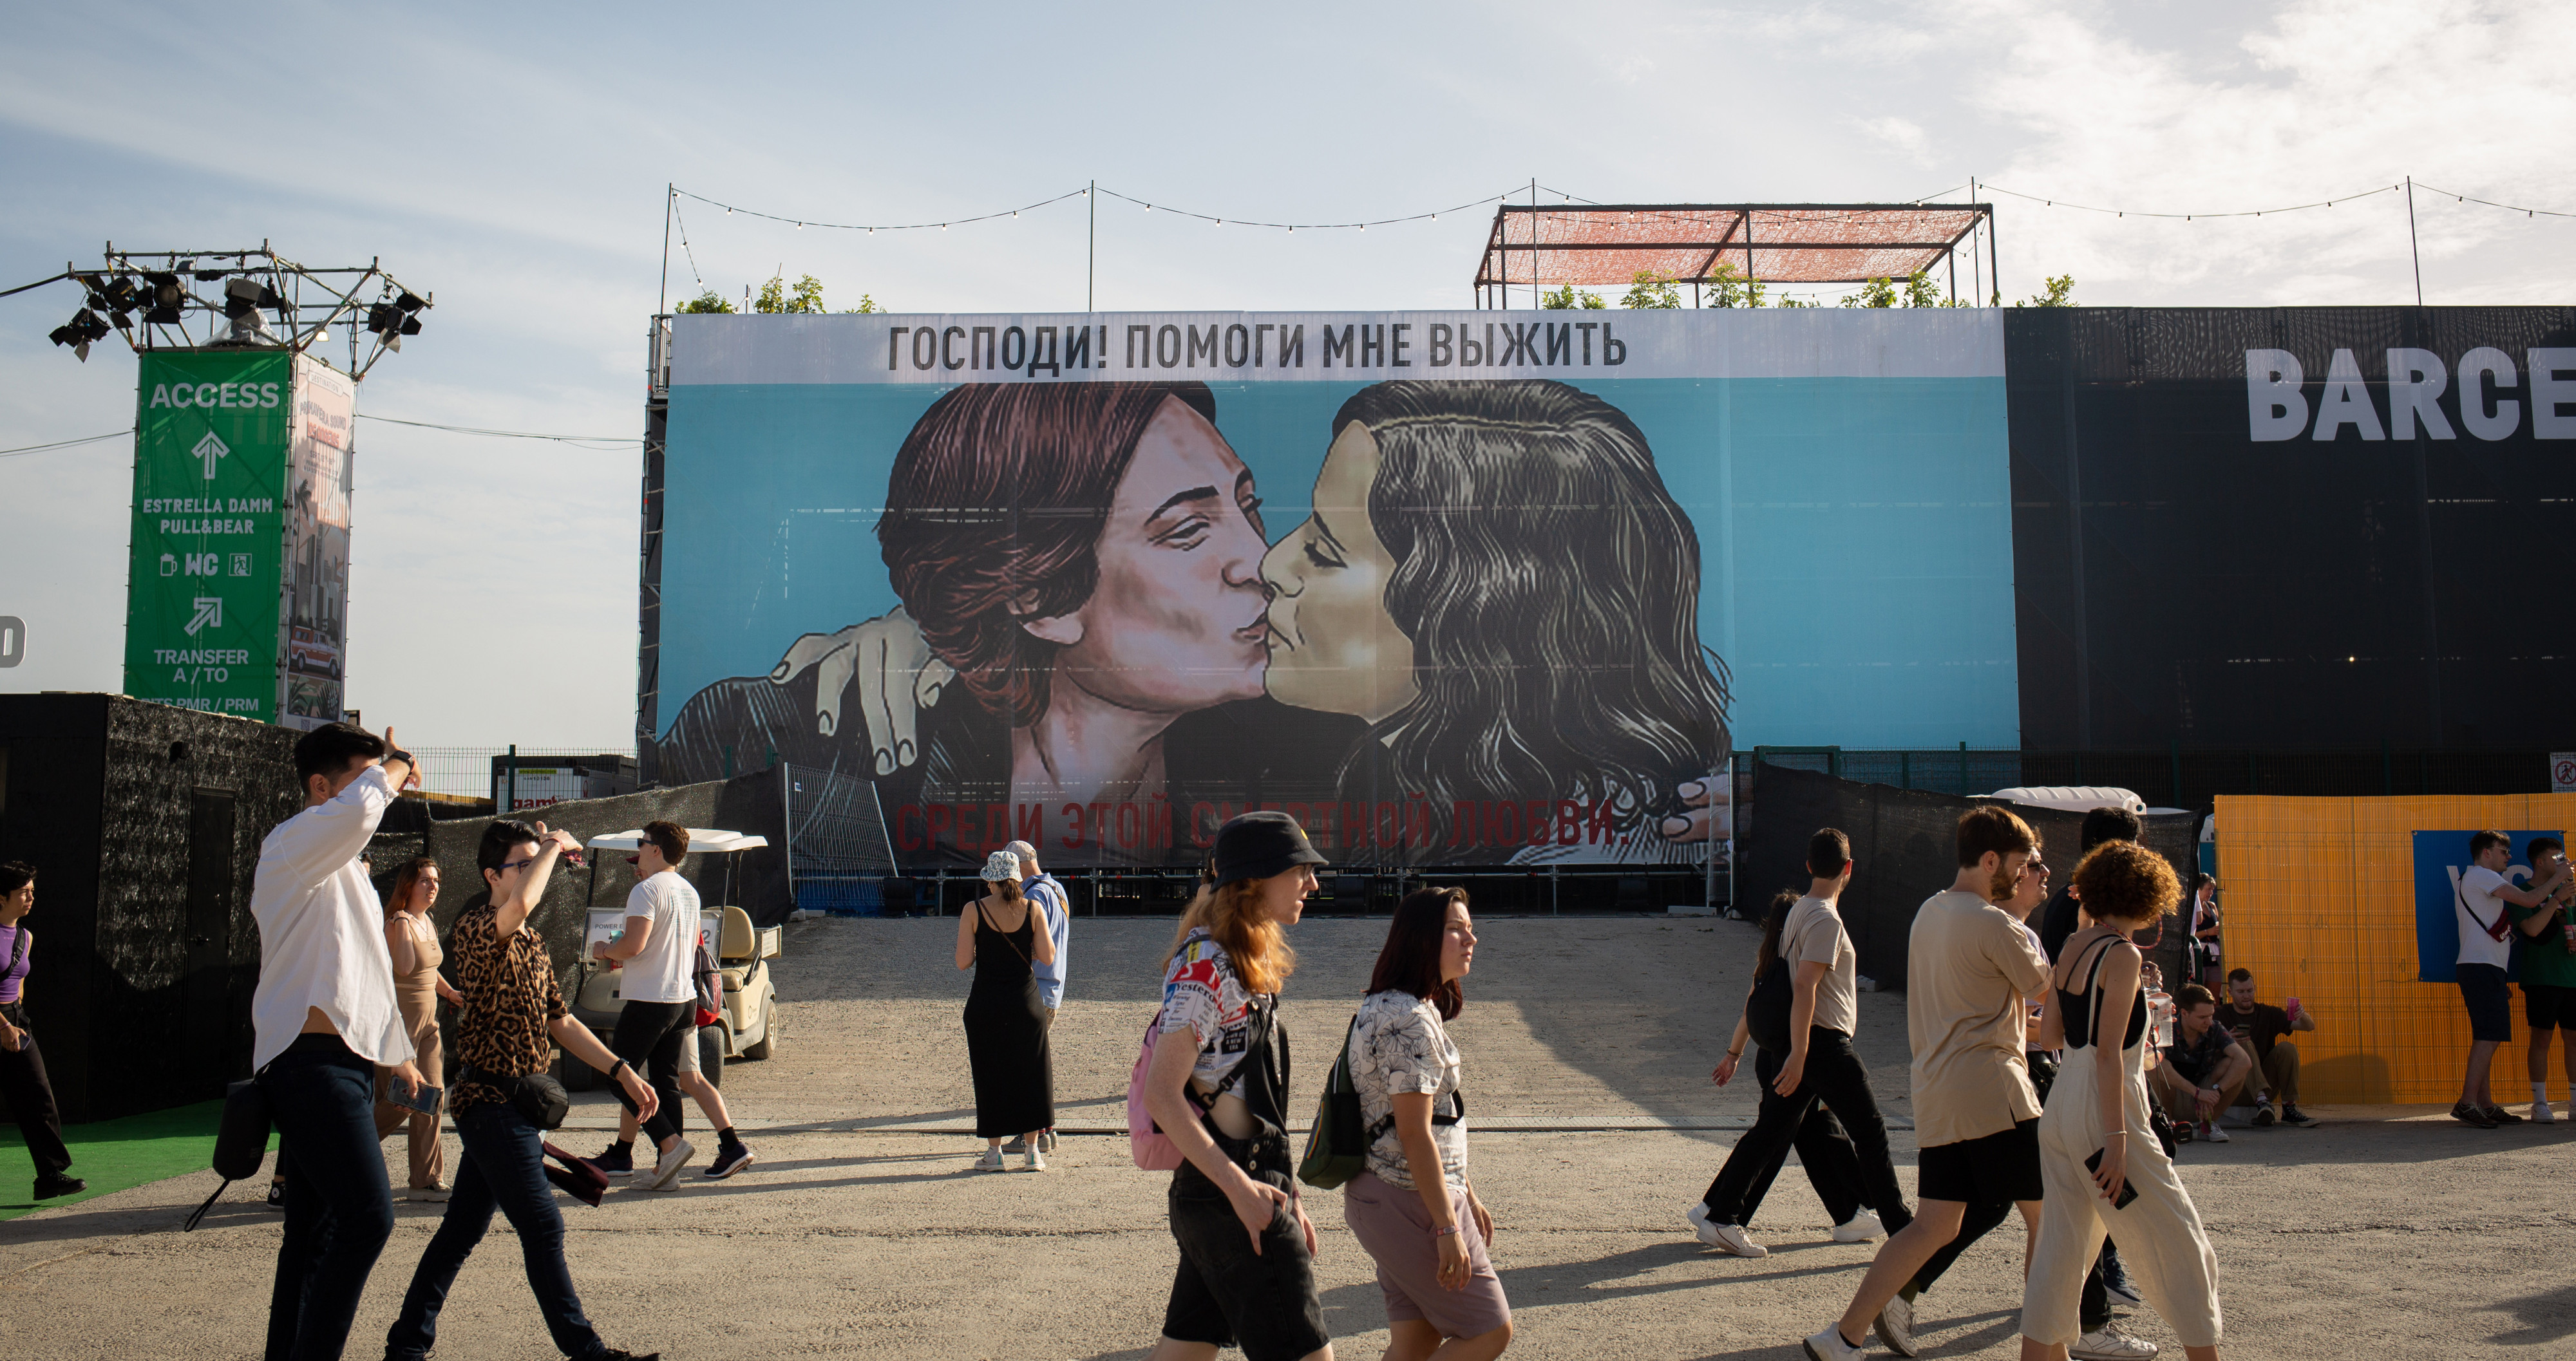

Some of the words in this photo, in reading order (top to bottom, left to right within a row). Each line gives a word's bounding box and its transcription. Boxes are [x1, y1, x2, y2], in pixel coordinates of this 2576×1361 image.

[889, 324, 1107, 378] ГОСПОДИ!
[1126, 324, 1303, 368] ПОМОГИ
[1323, 323, 1412, 368] МНЕ
[1429, 322, 1627, 367] ВЫЖИТЬ
[311, 374, 339, 393] DESTINATION
[2246, 346, 2576, 442] BARCE
[149, 382, 281, 409] ACCESS
[299, 400, 329, 426] PRIMAVERA
[330, 415, 346, 431] SOUND
[142, 499, 222, 514] ESTRELLA
[229, 498, 273, 513] DAMM
[160, 519, 254, 534] PULL&BEAR
[185, 552, 218, 576] WC
[154, 649, 249, 664] TRANSFER
[173, 667, 187, 682] A
[191, 666, 200, 684] /
[204, 667, 229, 683] TO
[176, 698, 211, 711] PMR
[214, 697, 222, 712] /
[225, 698, 260, 711] PRM
[897, 803, 1043, 858] СРЕДИ
[1061, 792, 1173, 849] ЭТОЙ
[1191, 791, 1430, 849] СРТНОЙ
[1448, 800, 1629, 849] ЛЮБВИ.
